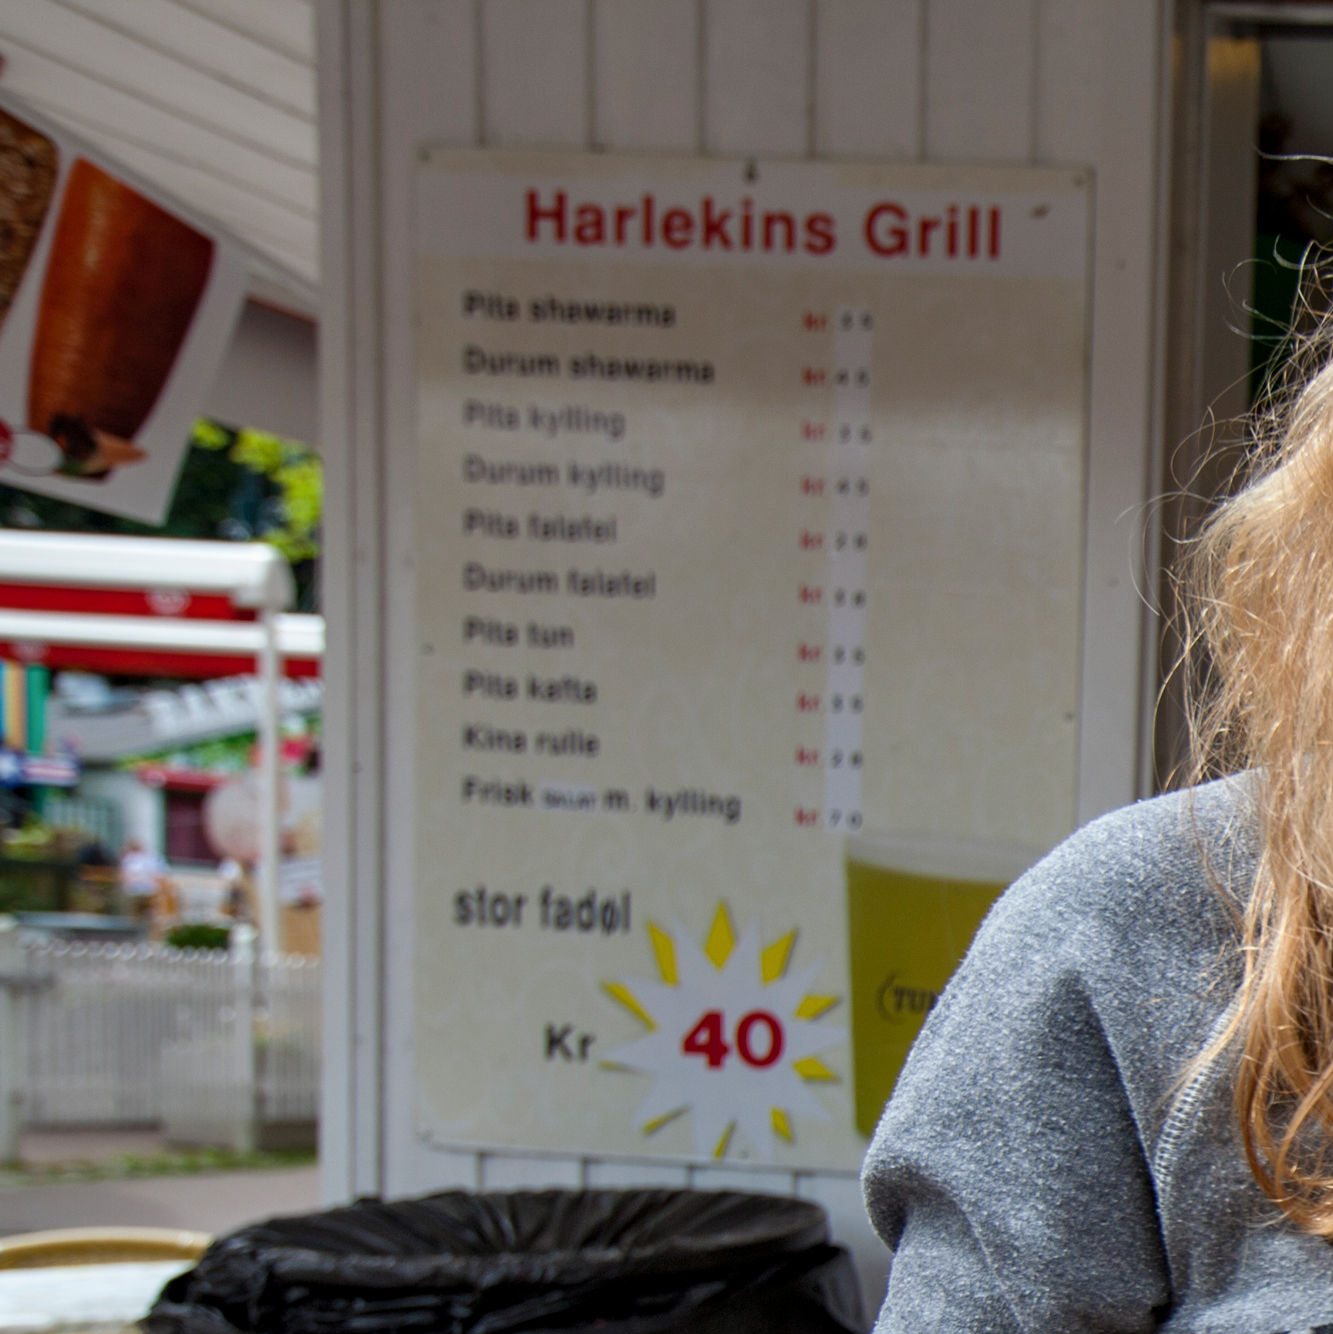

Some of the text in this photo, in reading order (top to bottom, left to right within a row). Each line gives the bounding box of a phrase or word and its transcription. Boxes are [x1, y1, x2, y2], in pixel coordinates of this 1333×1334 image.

[524, 188, 1003, 260] Harlekins Grill
[463, 291, 520, 323] Pita
[529, 296, 676, 328] shawarma
[462, 346, 561, 378] Durum
[568, 354, 715, 386] shawarma
[462, 399, 520, 431] Pita
[527, 404, 627, 441] kylling
[462, 454, 560, 487] Durum
[567, 461, 666, 499] kylling
[463, 509, 520, 540] Pita
[527, 512, 617, 544] falafel
[462, 562, 558, 595] Durum
[566, 567, 657, 600] falafel
[463, 616, 519, 647] Pita
[526, 620, 575, 650] tun
[462, 669, 519, 701] Pita
[462, 724, 528, 754] Kina
[534, 728, 601, 758] rulle
[462, 776, 533, 809] Frisk
[645, 787, 742, 827] kylling
[453, 886, 631, 935] stor fadøl
[545, 1009, 785, 1070] Kr 40
